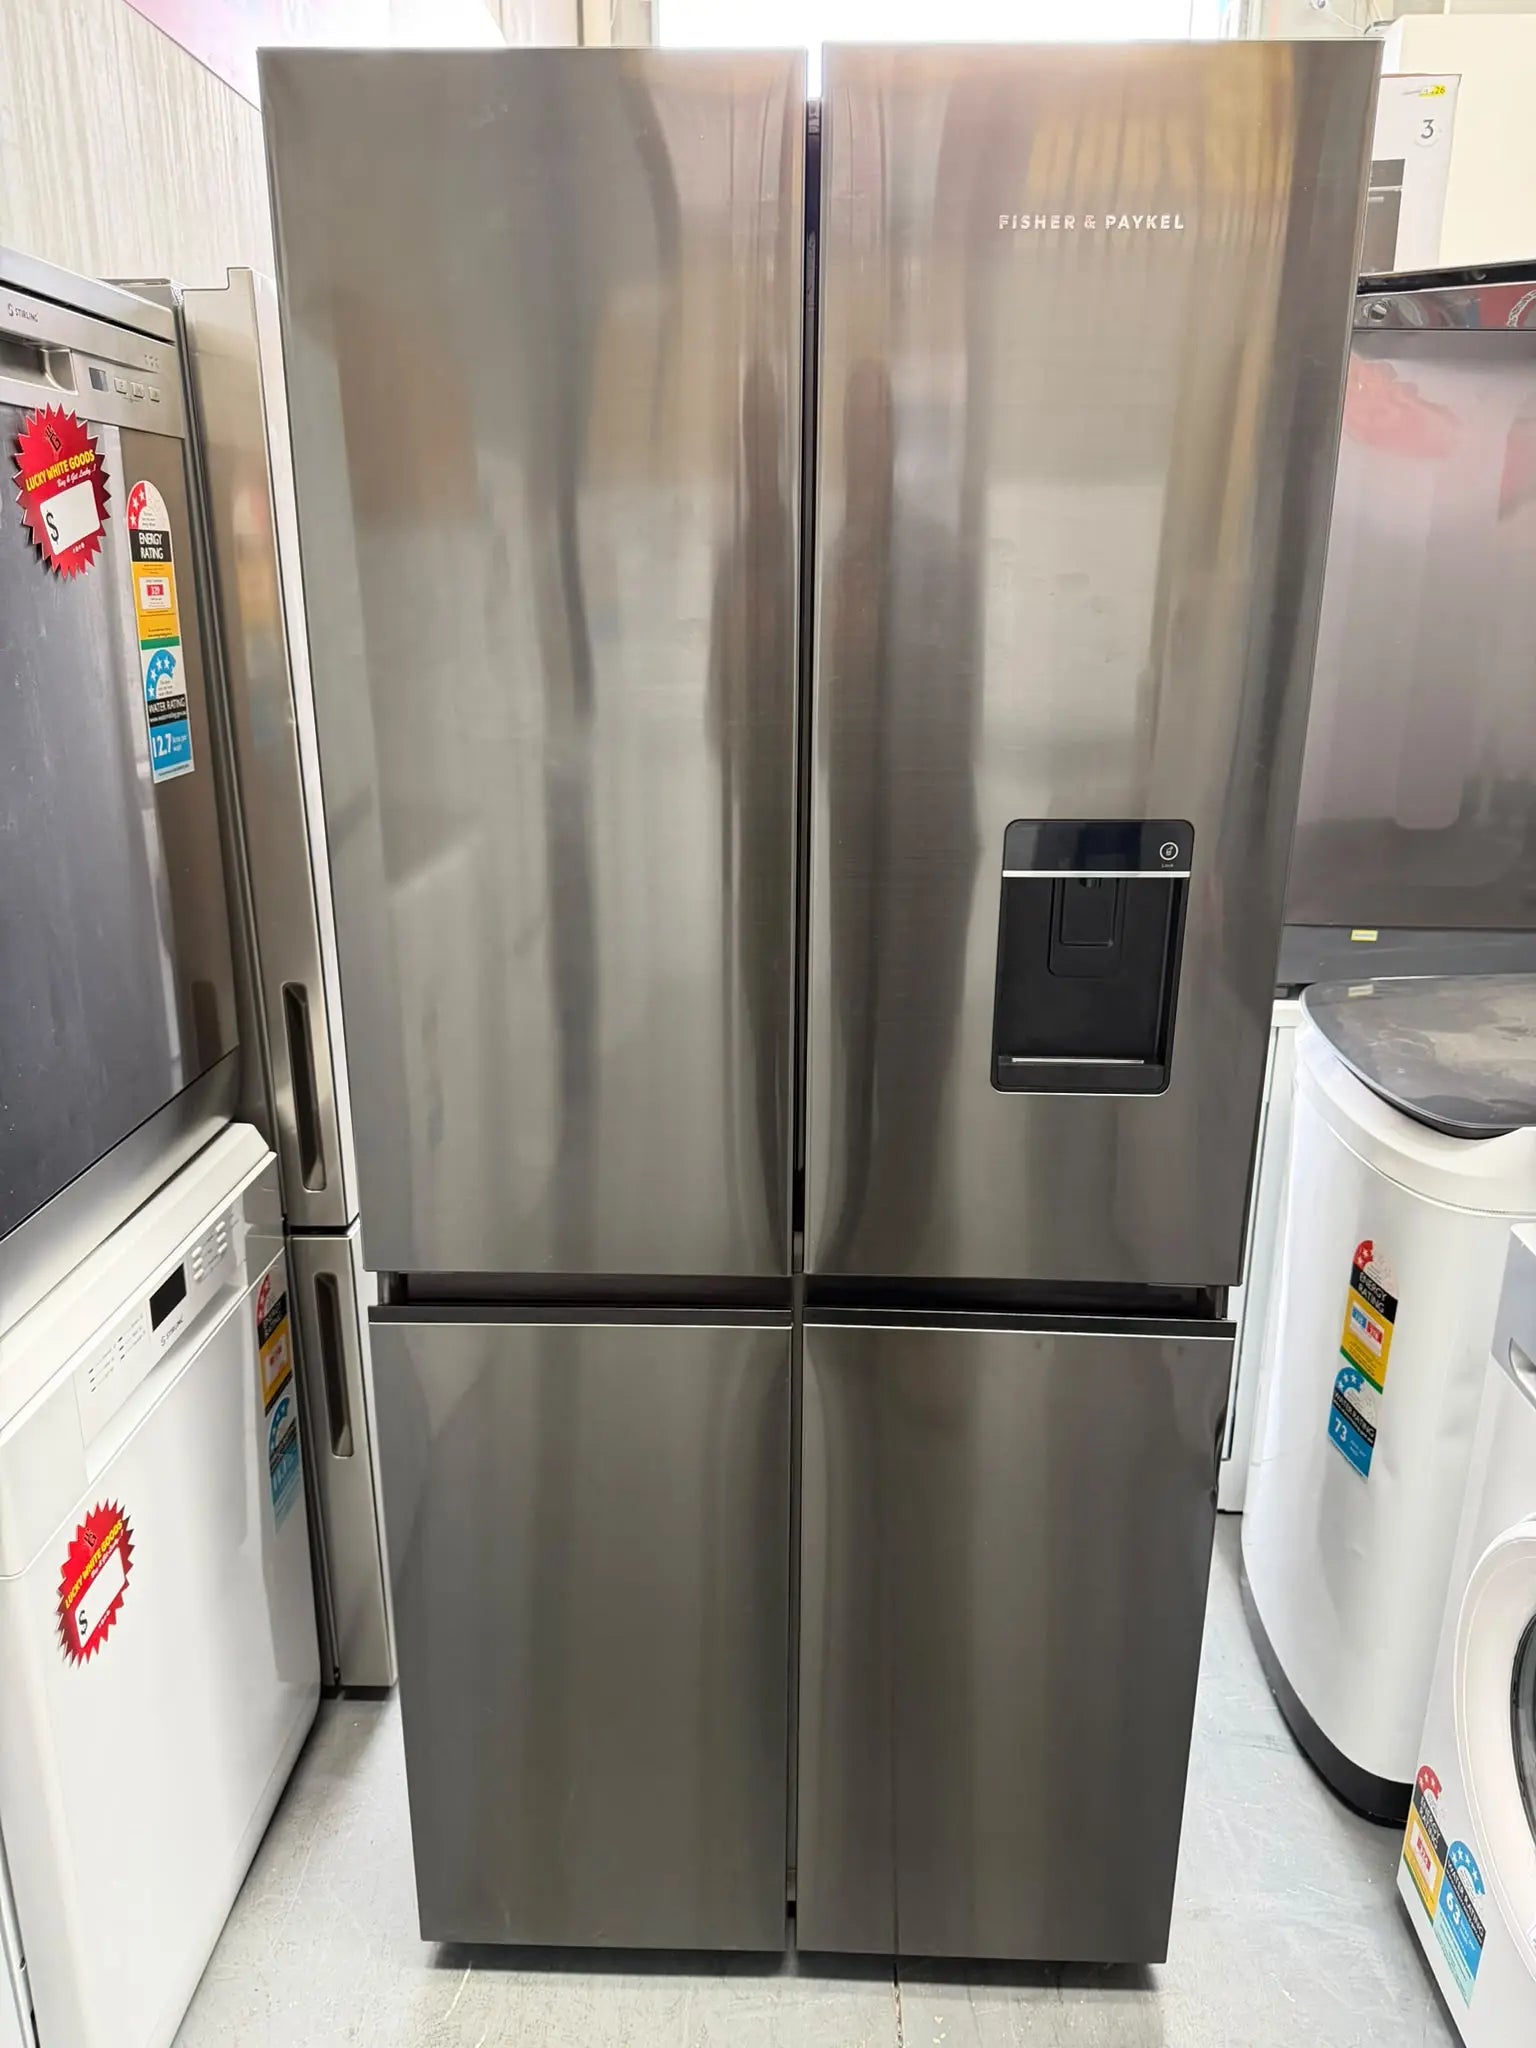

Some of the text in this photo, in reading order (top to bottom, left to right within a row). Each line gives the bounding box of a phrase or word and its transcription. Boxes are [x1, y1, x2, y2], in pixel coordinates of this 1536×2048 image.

[999, 214, 1184, 230] FISHER & PAYKEL
[25, 449, 96, 492] LUCKY WHITE GOODS
[139, 532, 163, 545] ENERGY
[140, 547, 163, 560] RATING
[149, 697, 187, 714] WATER RATING
[1357, 1282, 1385, 1314] RATING
[1359, 1271, 1388, 1301] ENERGY
[1335, 1416, 1347, 1442] 73
[64, 1574, 83, 1610] LUCKY
[82, 1547, 102, 1580] WHITE
[100, 1519, 123, 1553] GOODS
[1446, 1891, 1461, 1925] 63
